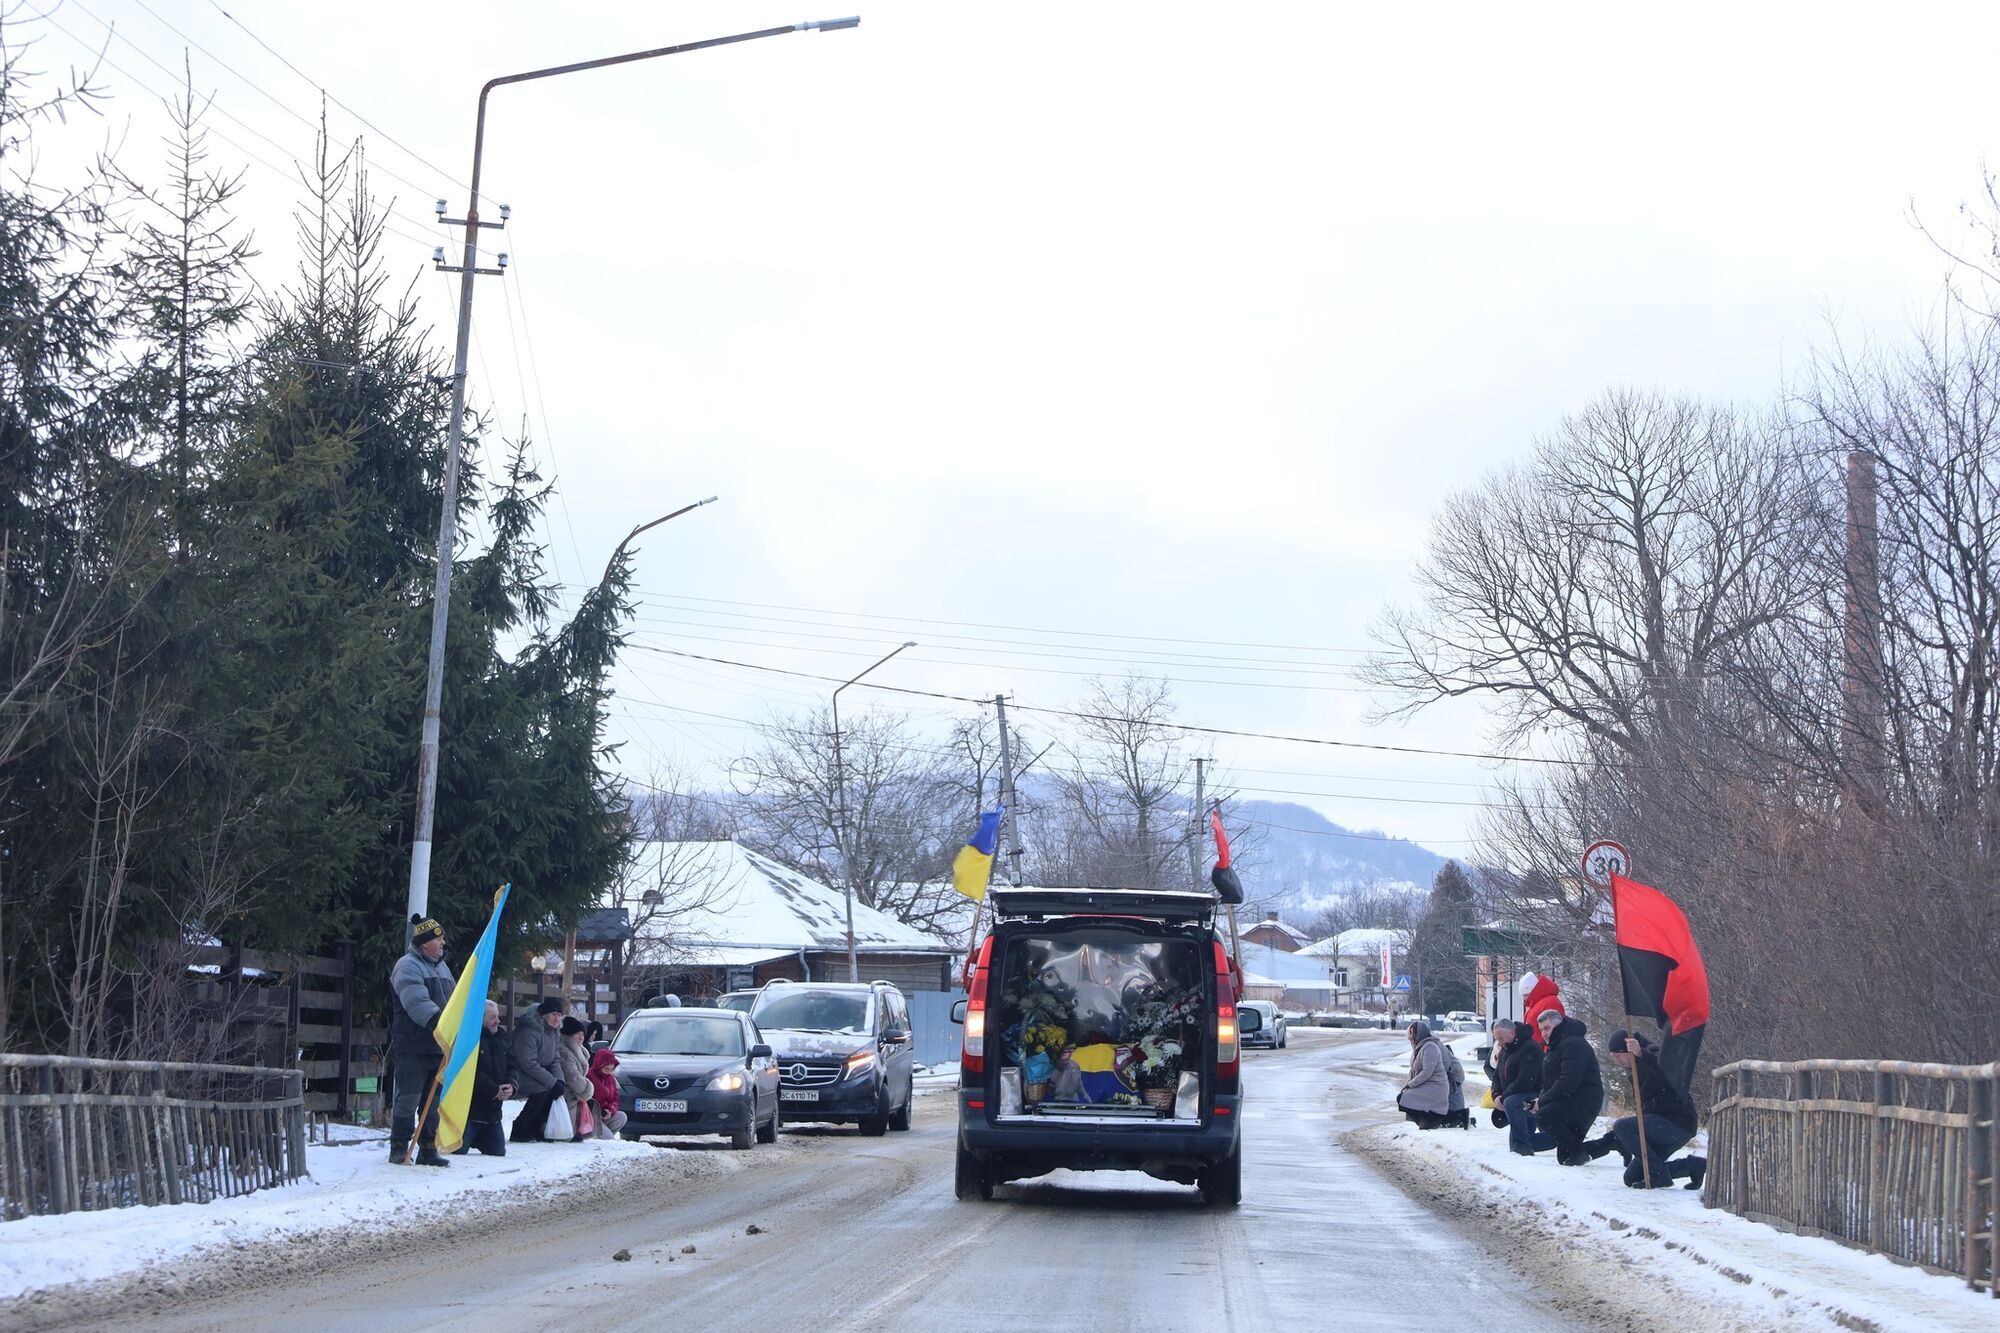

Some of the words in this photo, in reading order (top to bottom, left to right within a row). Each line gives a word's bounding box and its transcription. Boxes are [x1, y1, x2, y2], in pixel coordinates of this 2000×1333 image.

[1594, 856, 1620, 875] 30
[641, 1101, 652, 1110] BC
[654, 1102, 672, 1110] 5069
[673, 1102, 685, 1111] PO
